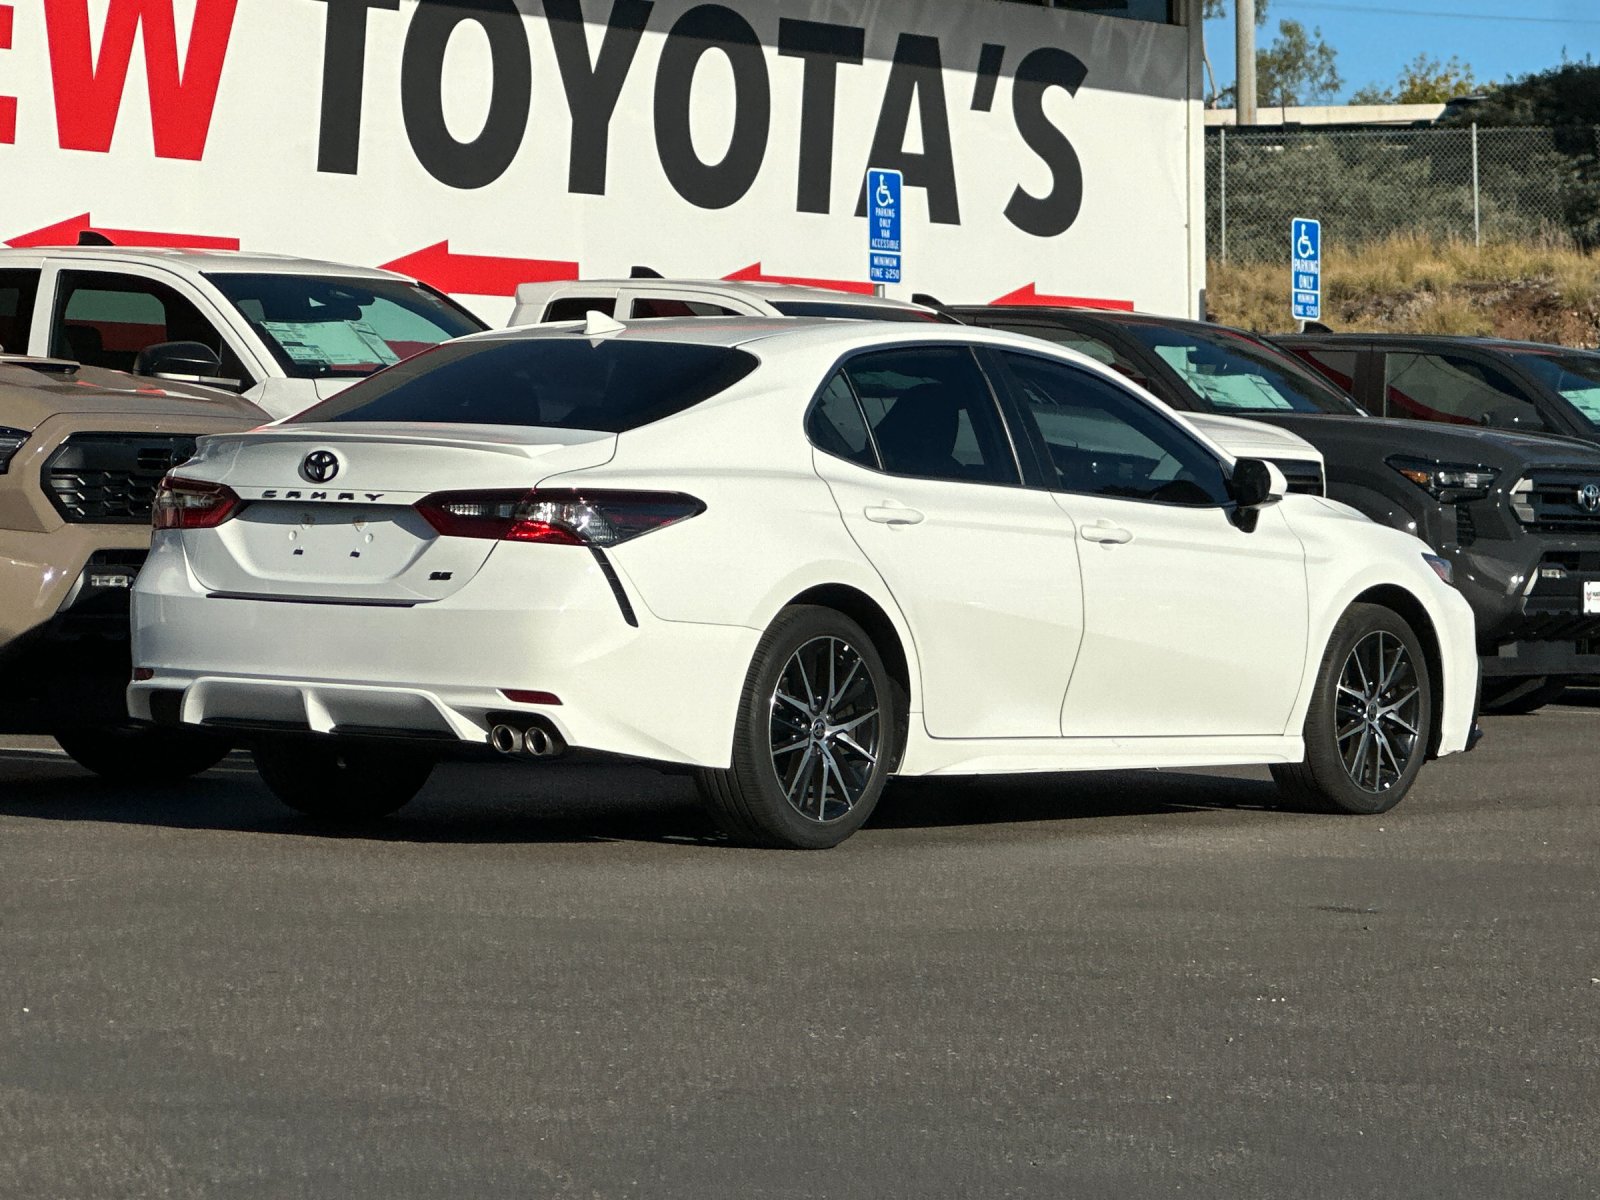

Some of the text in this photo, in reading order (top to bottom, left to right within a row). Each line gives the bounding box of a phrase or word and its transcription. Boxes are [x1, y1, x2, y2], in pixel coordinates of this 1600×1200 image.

[310, 0, 1089, 237] TOYOTA'S
[875, 207, 895, 218] PARKING
[879, 218, 891, 228] ONLY
[881, 229, 890, 238] VAN
[872, 238, 899, 249] ACCESSIBLE
[874, 256, 897, 267] MINIMUM
[1294, 259, 1318, 274] PARKING
[871, 268, 900, 279] FINE $250
[1298, 274, 1314, 289] ONLY
[262, 490, 384, 501] CAMRY
